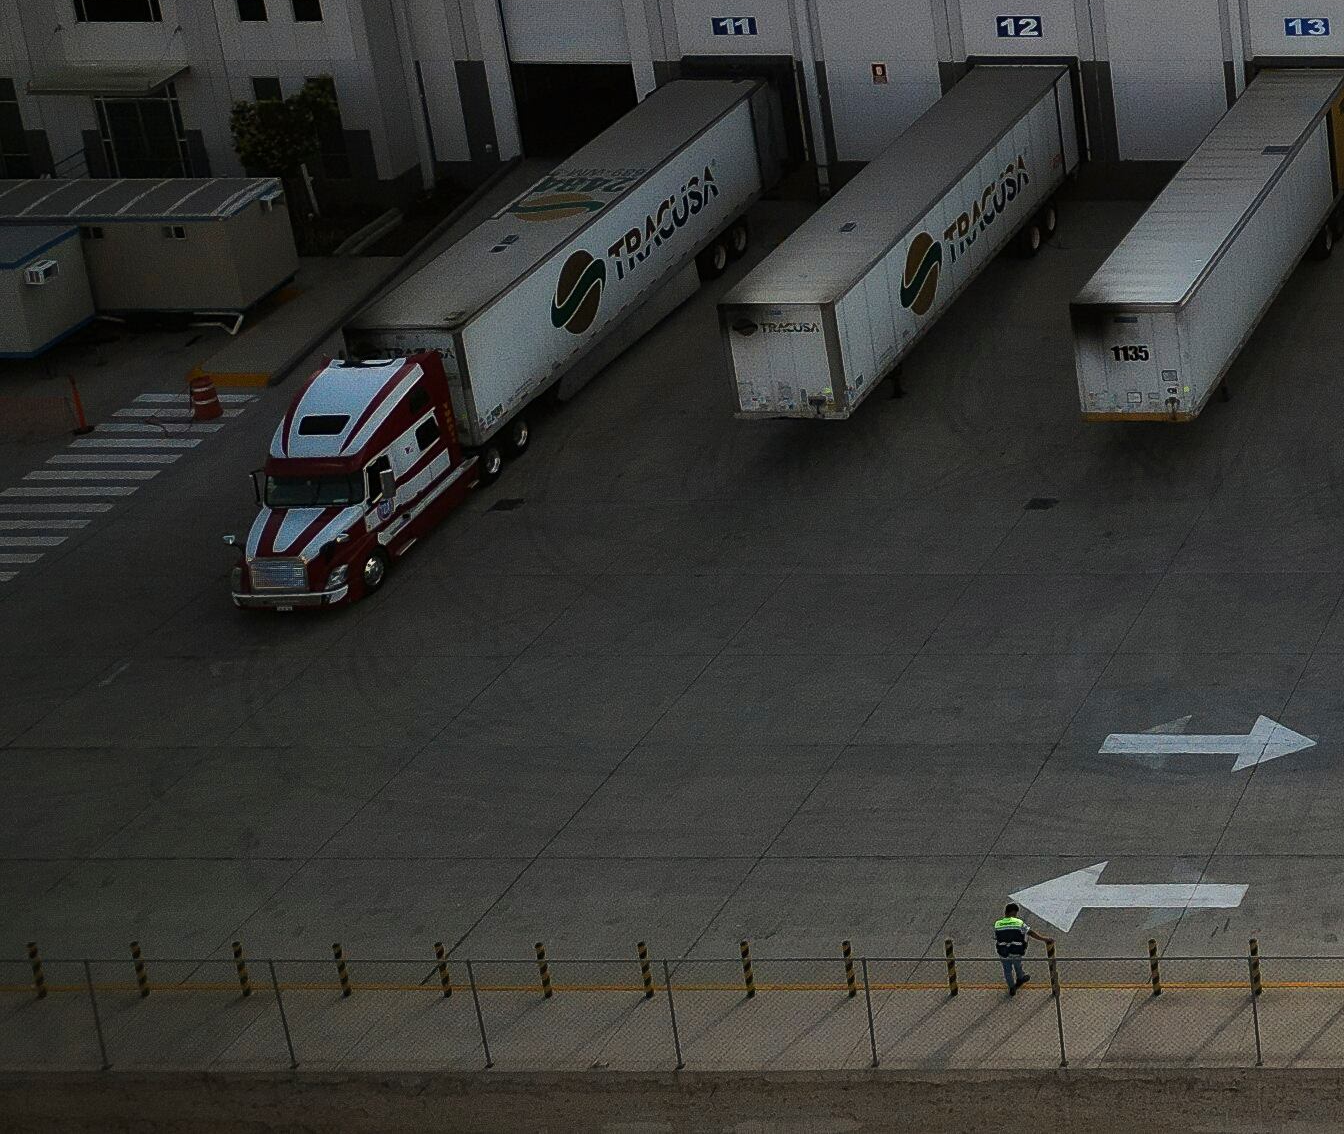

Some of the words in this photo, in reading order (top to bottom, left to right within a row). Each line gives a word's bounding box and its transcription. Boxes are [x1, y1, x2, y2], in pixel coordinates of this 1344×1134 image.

[719, 18, 750, 35] 11
[1000, 18, 1039, 36] 12
[1288, 19, 1326, 35] 13
[943, 154, 1029, 263] TRACUSA
[607, 166, 719, 280] TRACUSA
[760, 322, 819, 333] TRACUSA
[1111, 345, 1149, 361] 1135
